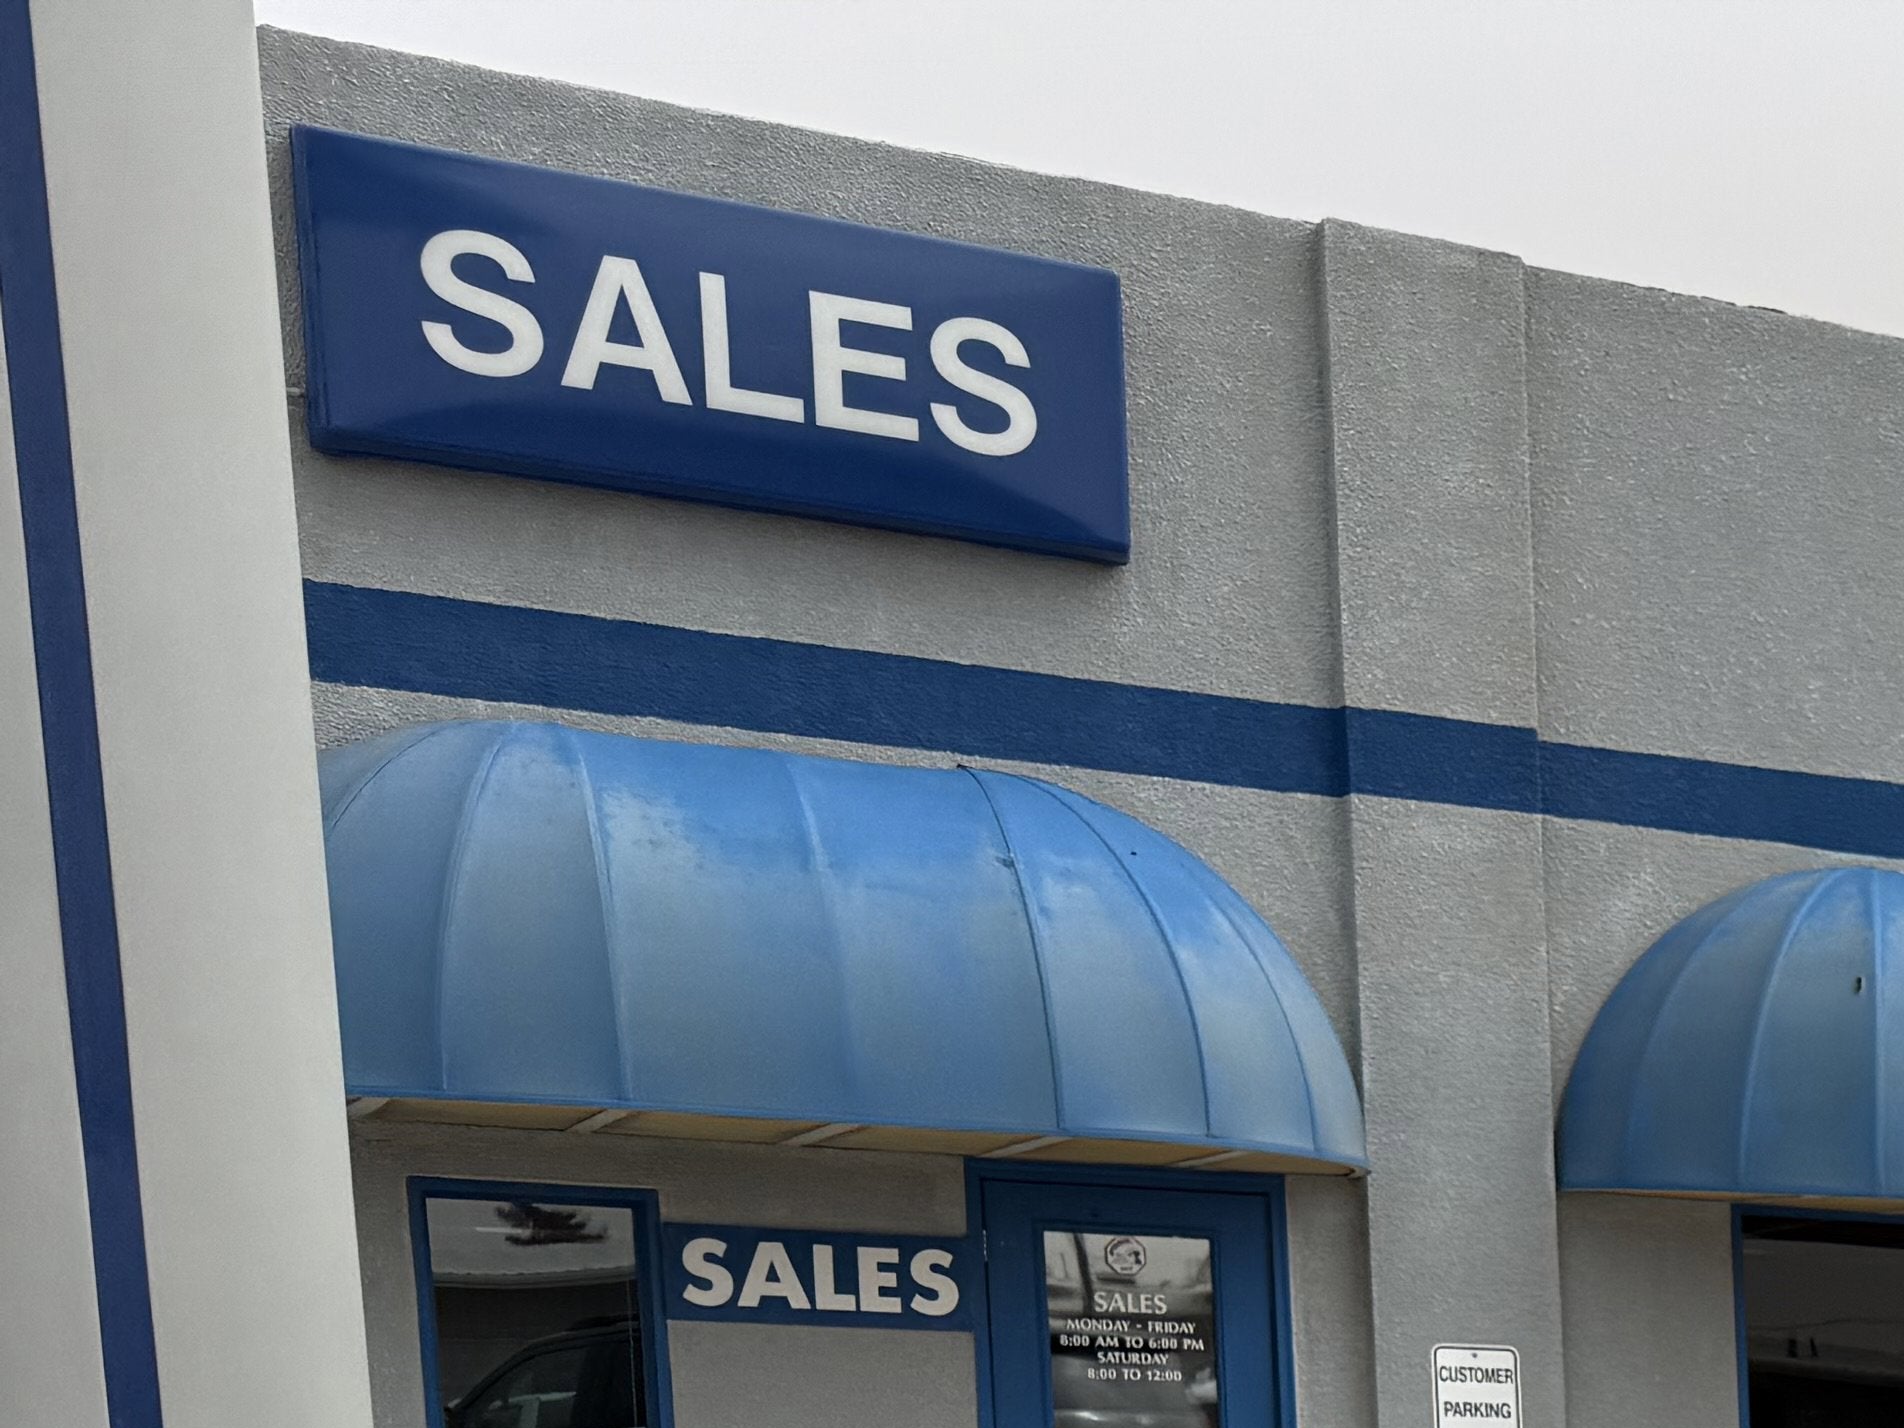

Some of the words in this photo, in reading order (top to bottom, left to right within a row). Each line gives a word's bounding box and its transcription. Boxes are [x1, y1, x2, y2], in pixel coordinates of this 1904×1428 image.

[420, 229, 1037, 456] SALES
[681, 1237, 960, 1317] SALES
[1094, 1291, 1167, 1315] SALES
[1066, 1317, 1131, 1332] MONDAY
[1147, 1320, 1196, 1334] FRIDAY
[1060, 1334, 1090, 1347] 8:00
[1095, 1335, 1119, 1348] AM
[1125, 1336, 1144, 1349] TO
[1148, 1336, 1178, 1350] 6:00
[1183, 1337, 1205, 1351] PM
[1097, 1351, 1169, 1365] SATURDAY
[1087, 1367, 1117, 1380] 8:00
[1121, 1368, 1141, 1381] TO
[1146, 1368, 1182, 1381] 12:00
[1439, 1365, 1514, 1384] CUSTOMER
[1443, 1401, 1512, 1419] PARKING
